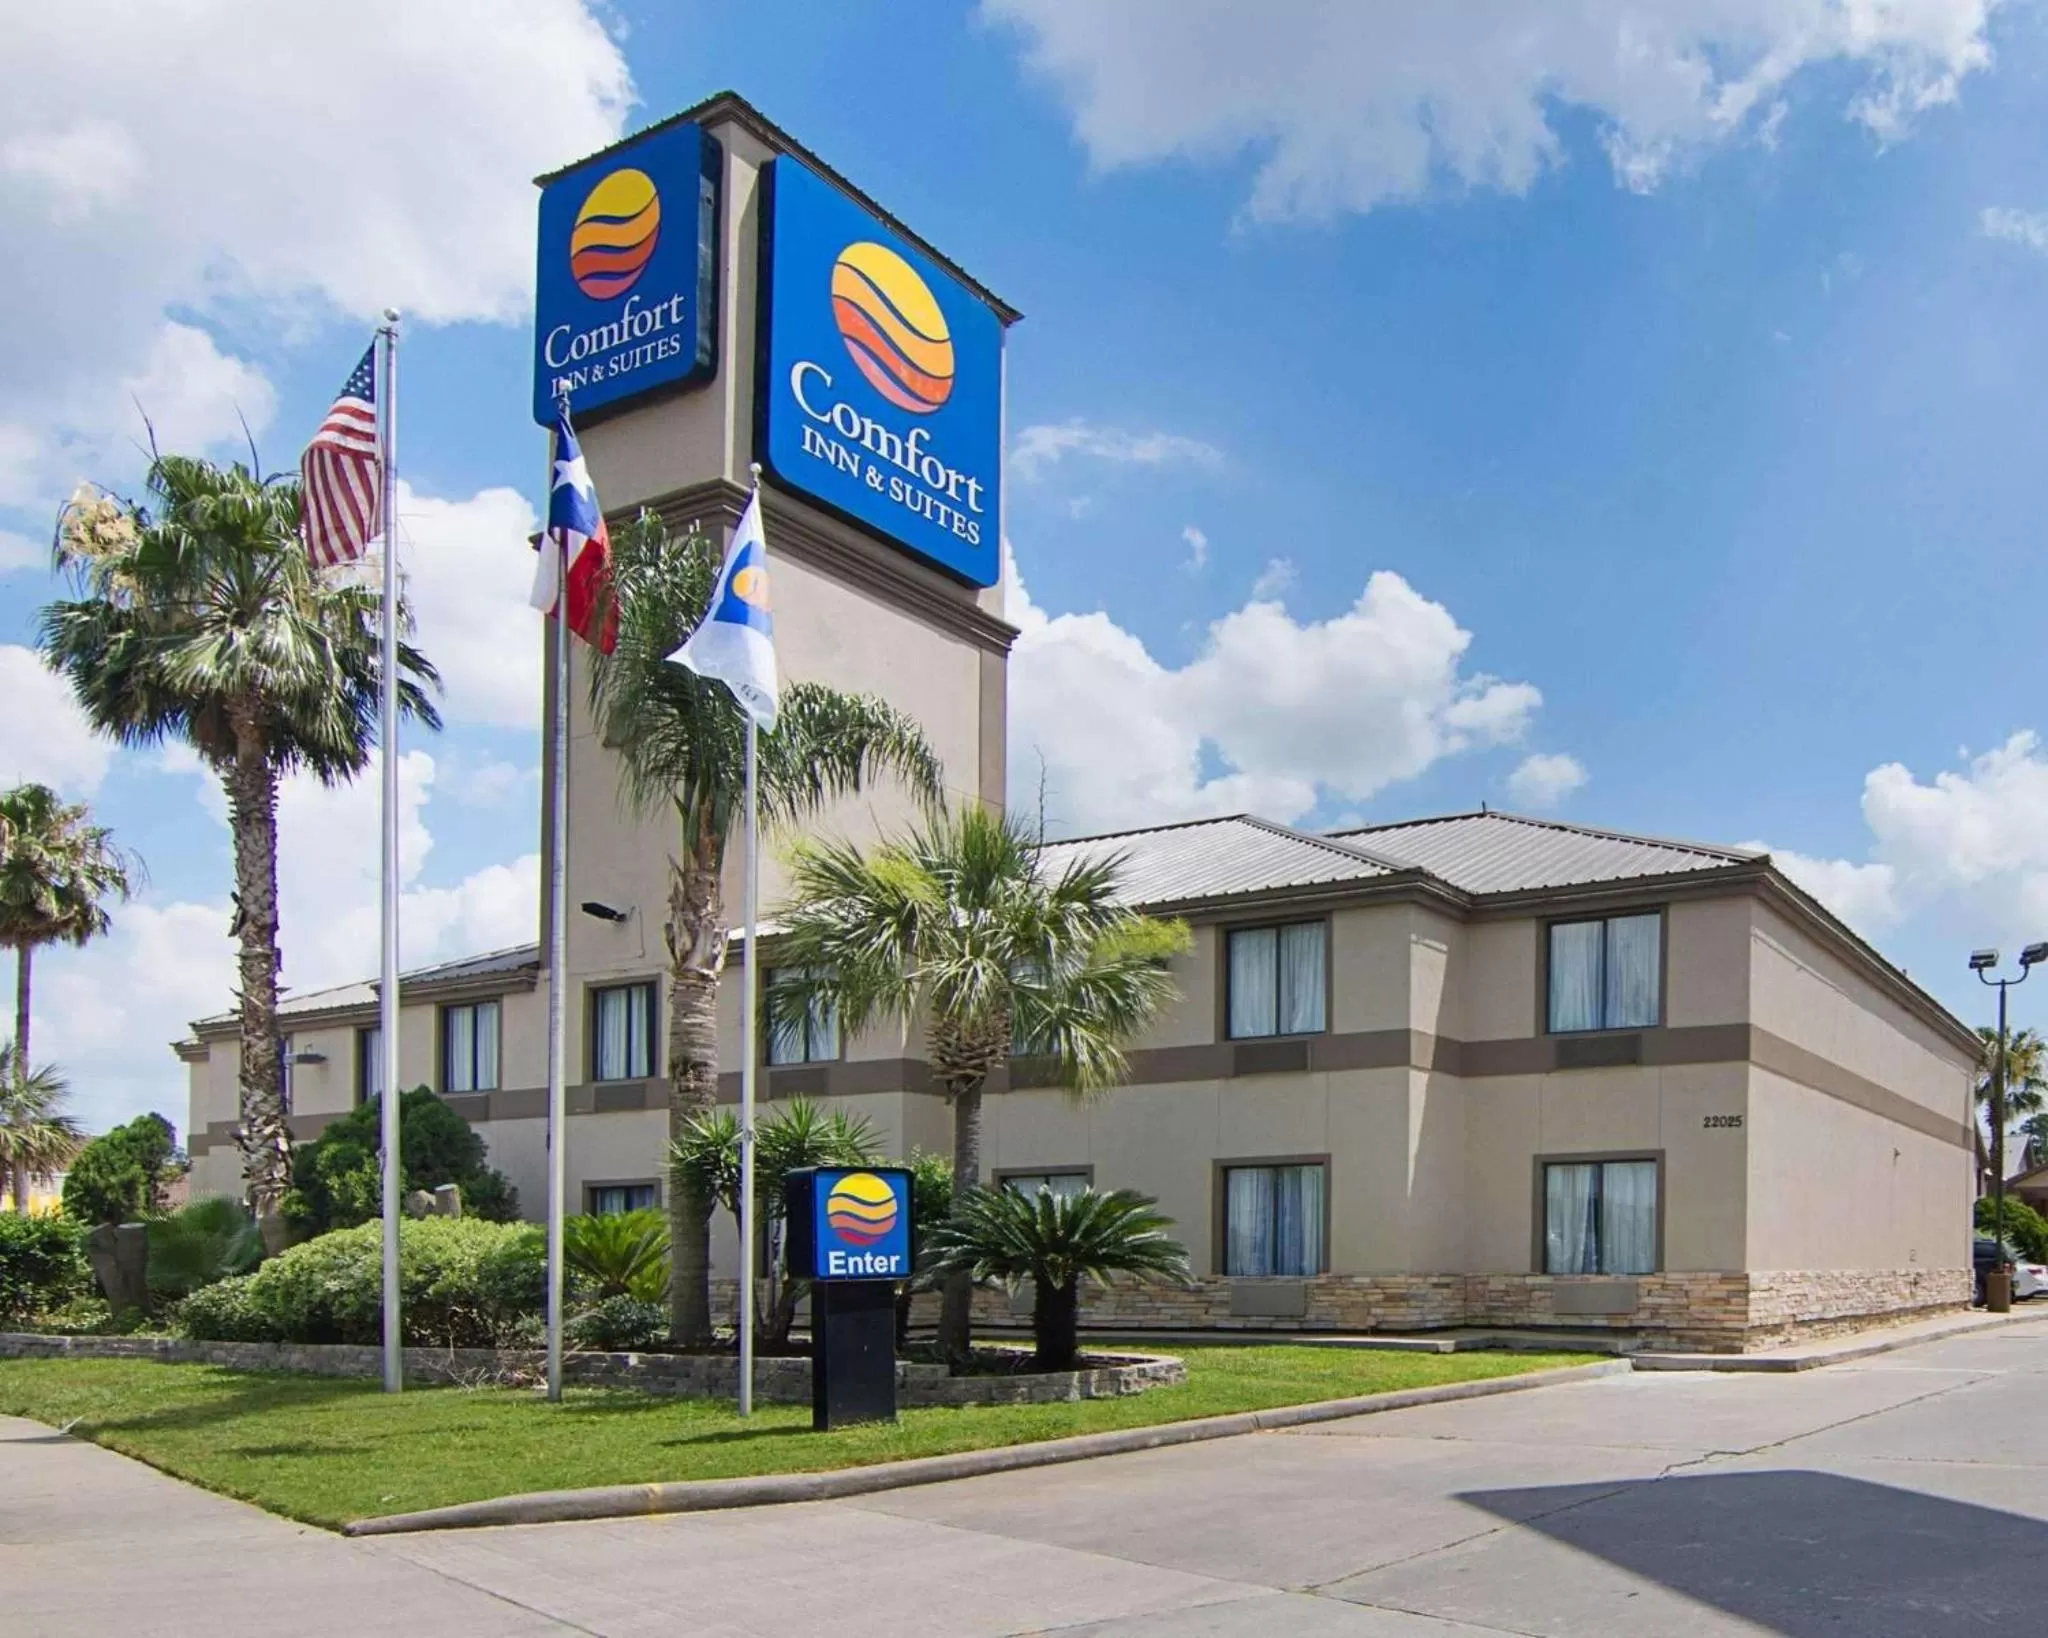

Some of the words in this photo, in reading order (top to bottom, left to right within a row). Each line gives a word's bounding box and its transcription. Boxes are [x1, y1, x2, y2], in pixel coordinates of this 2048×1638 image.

[544, 294, 684, 368] Comfort
[591, 364, 605, 383] &
[608, 333, 681, 377] SUITES
[790, 361, 984, 513] Comfort
[801, 424, 861, 477] INN
[865, 464, 884, 492] &
[889, 477, 980, 545] SUITES
[1703, 1115, 1742, 1128] 22025
[828, 1251, 900, 1275] Enter
